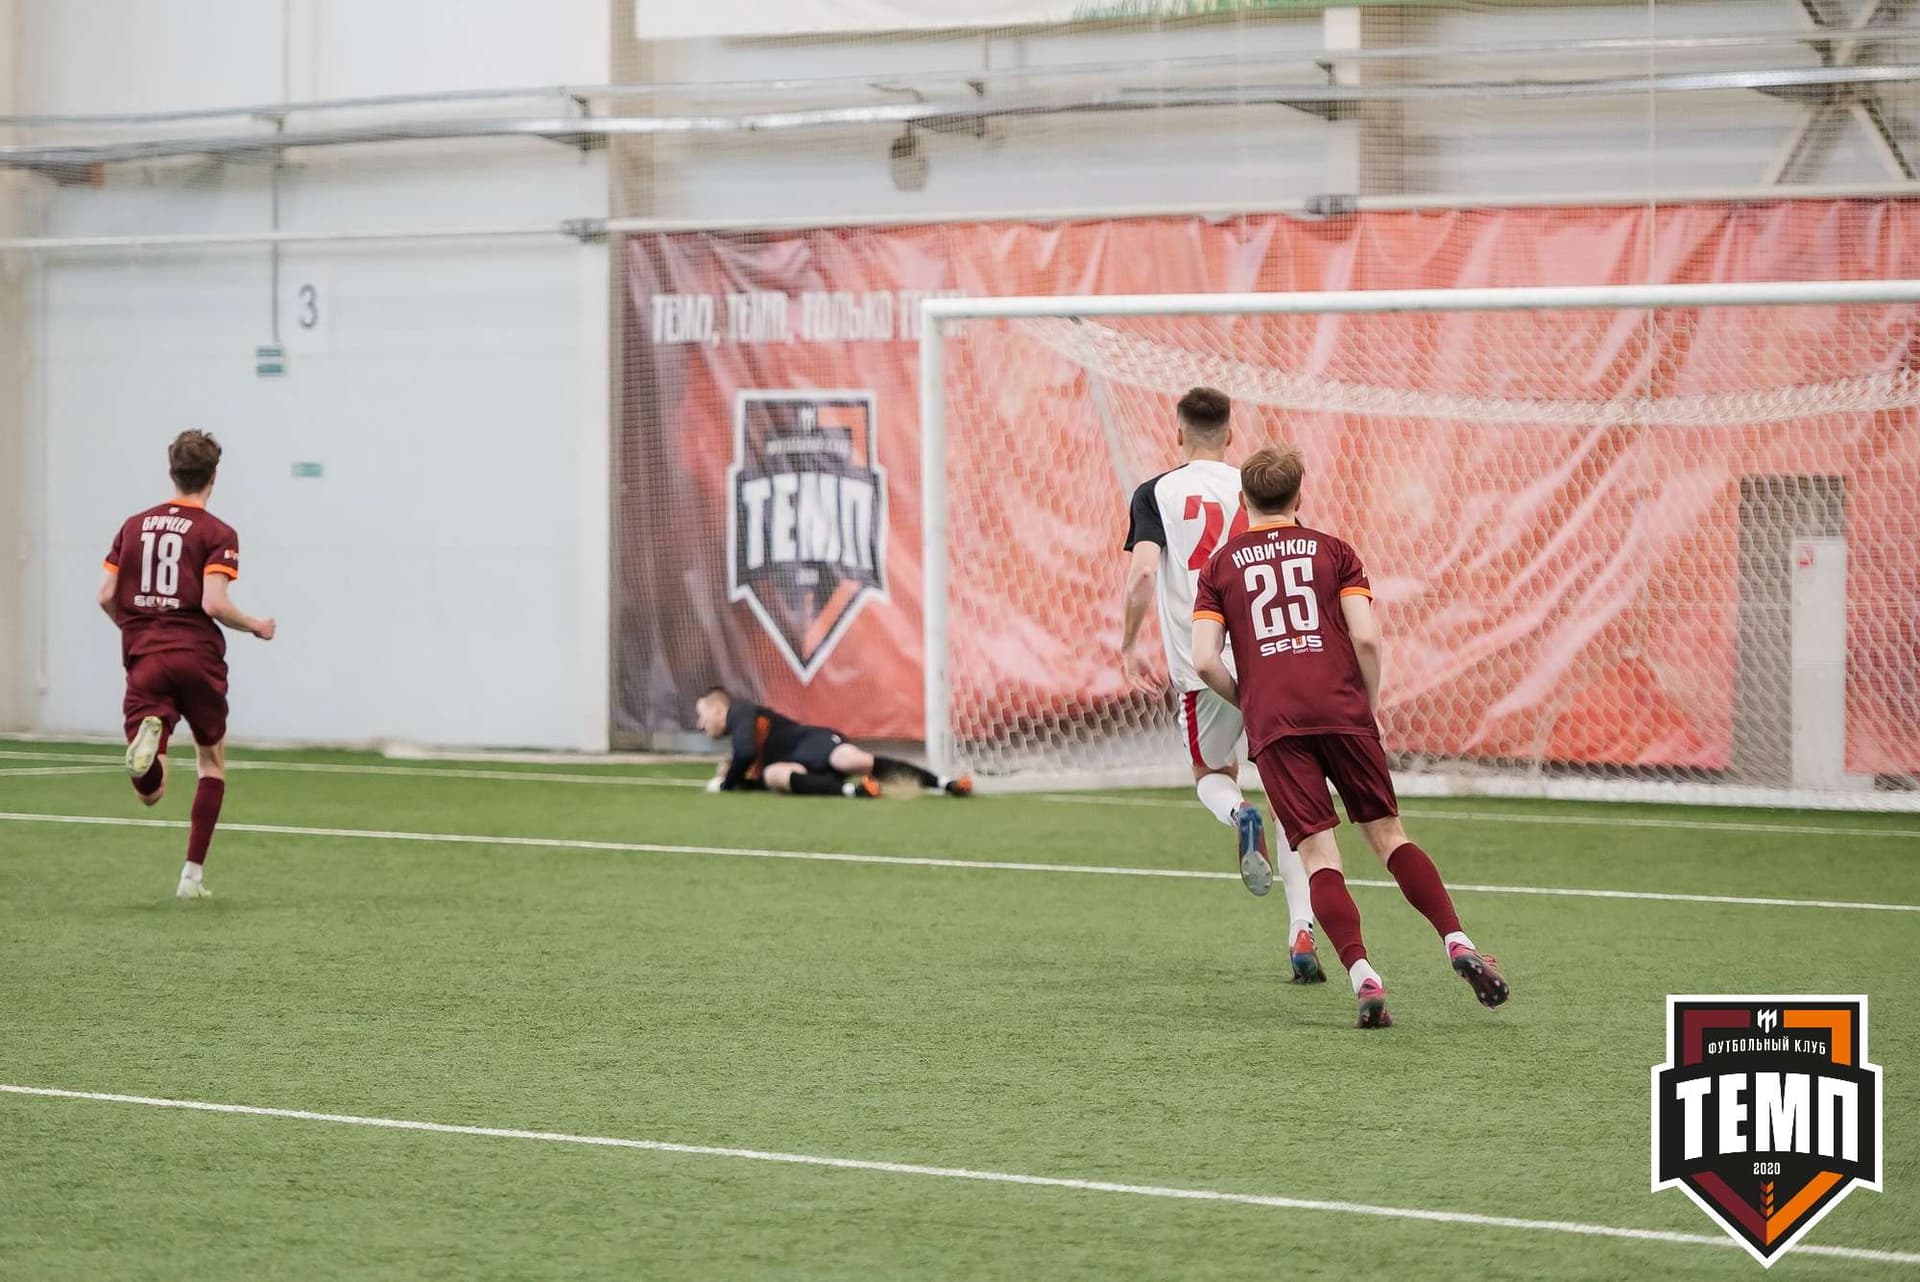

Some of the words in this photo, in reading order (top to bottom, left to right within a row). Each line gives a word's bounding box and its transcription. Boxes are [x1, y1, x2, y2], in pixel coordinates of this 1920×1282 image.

[298, 284, 319, 329] 3
[742, 472, 874, 571] ТЕМП
[140, 532, 183, 596] 18
[1231, 538, 1318, 569] НОВИЧКОВ
[1244, 557, 1319, 641] 25
[1259, 634, 1323, 657] SEUS
